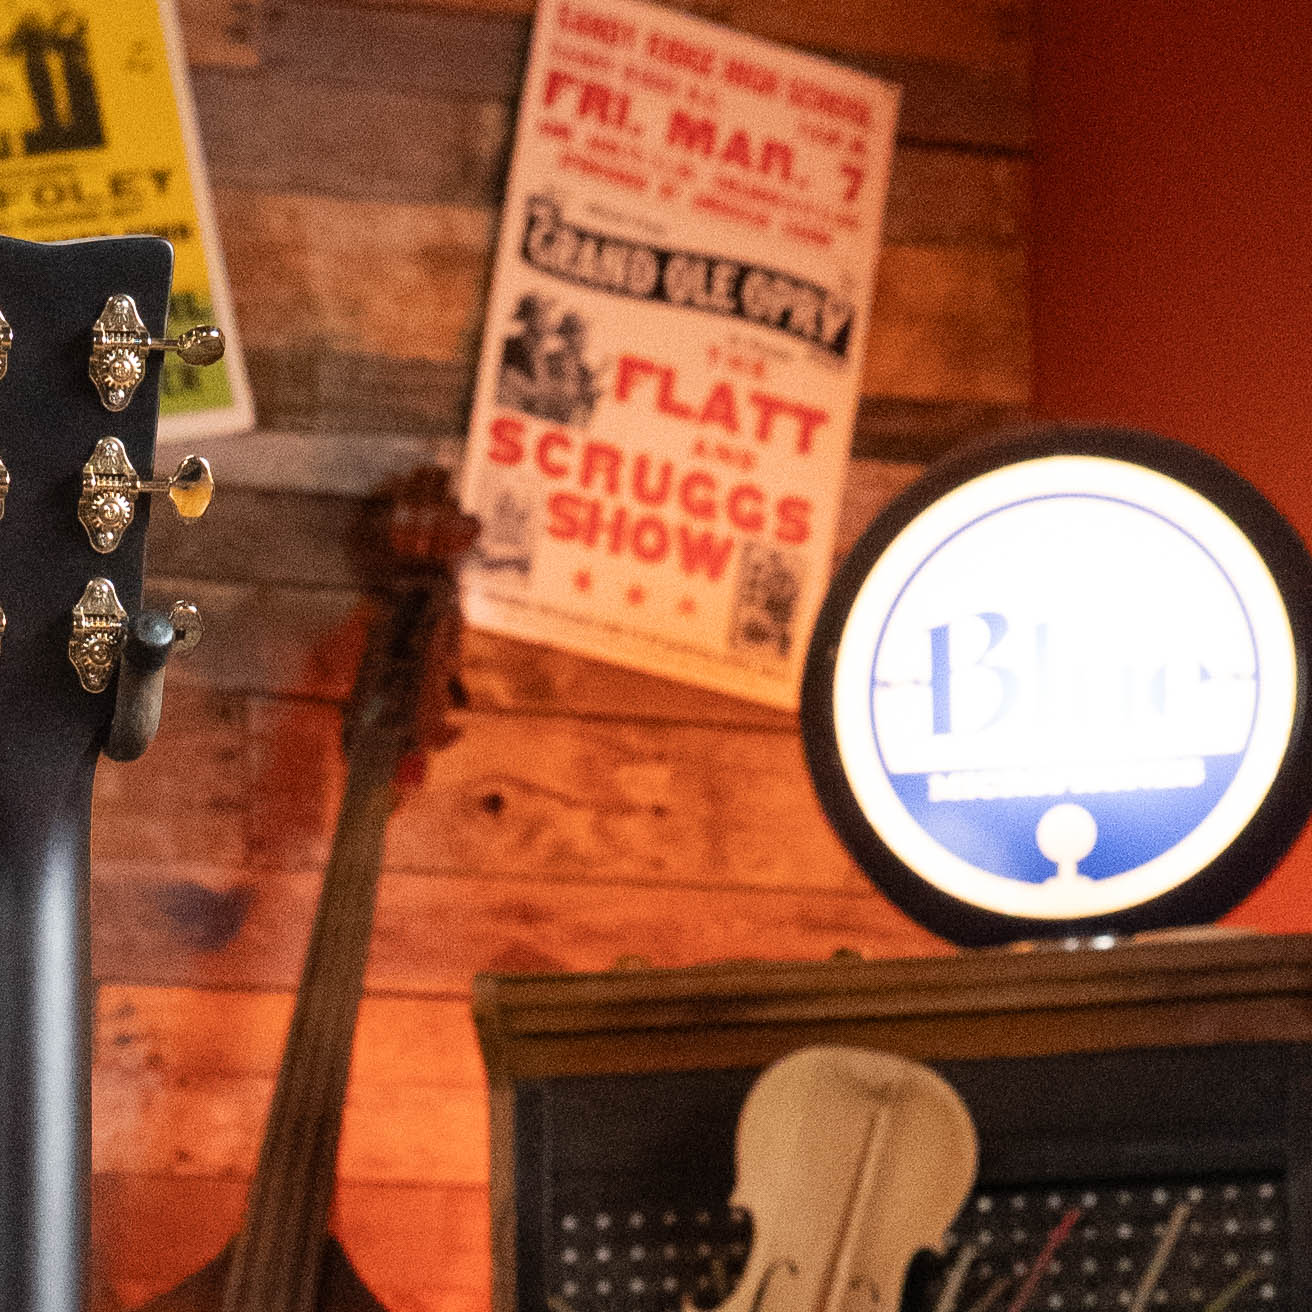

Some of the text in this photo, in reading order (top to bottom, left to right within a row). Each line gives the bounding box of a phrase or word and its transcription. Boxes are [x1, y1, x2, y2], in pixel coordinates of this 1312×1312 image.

[544, 69, 643, 137] FRI.
[666, 109, 810, 189] MAR.
[841, 164, 866, 204] 7
[614, 354, 830, 456] FLATT
[488, 416, 813, 546] SCRUGGS
[546, 491, 735, 582] SHOW
